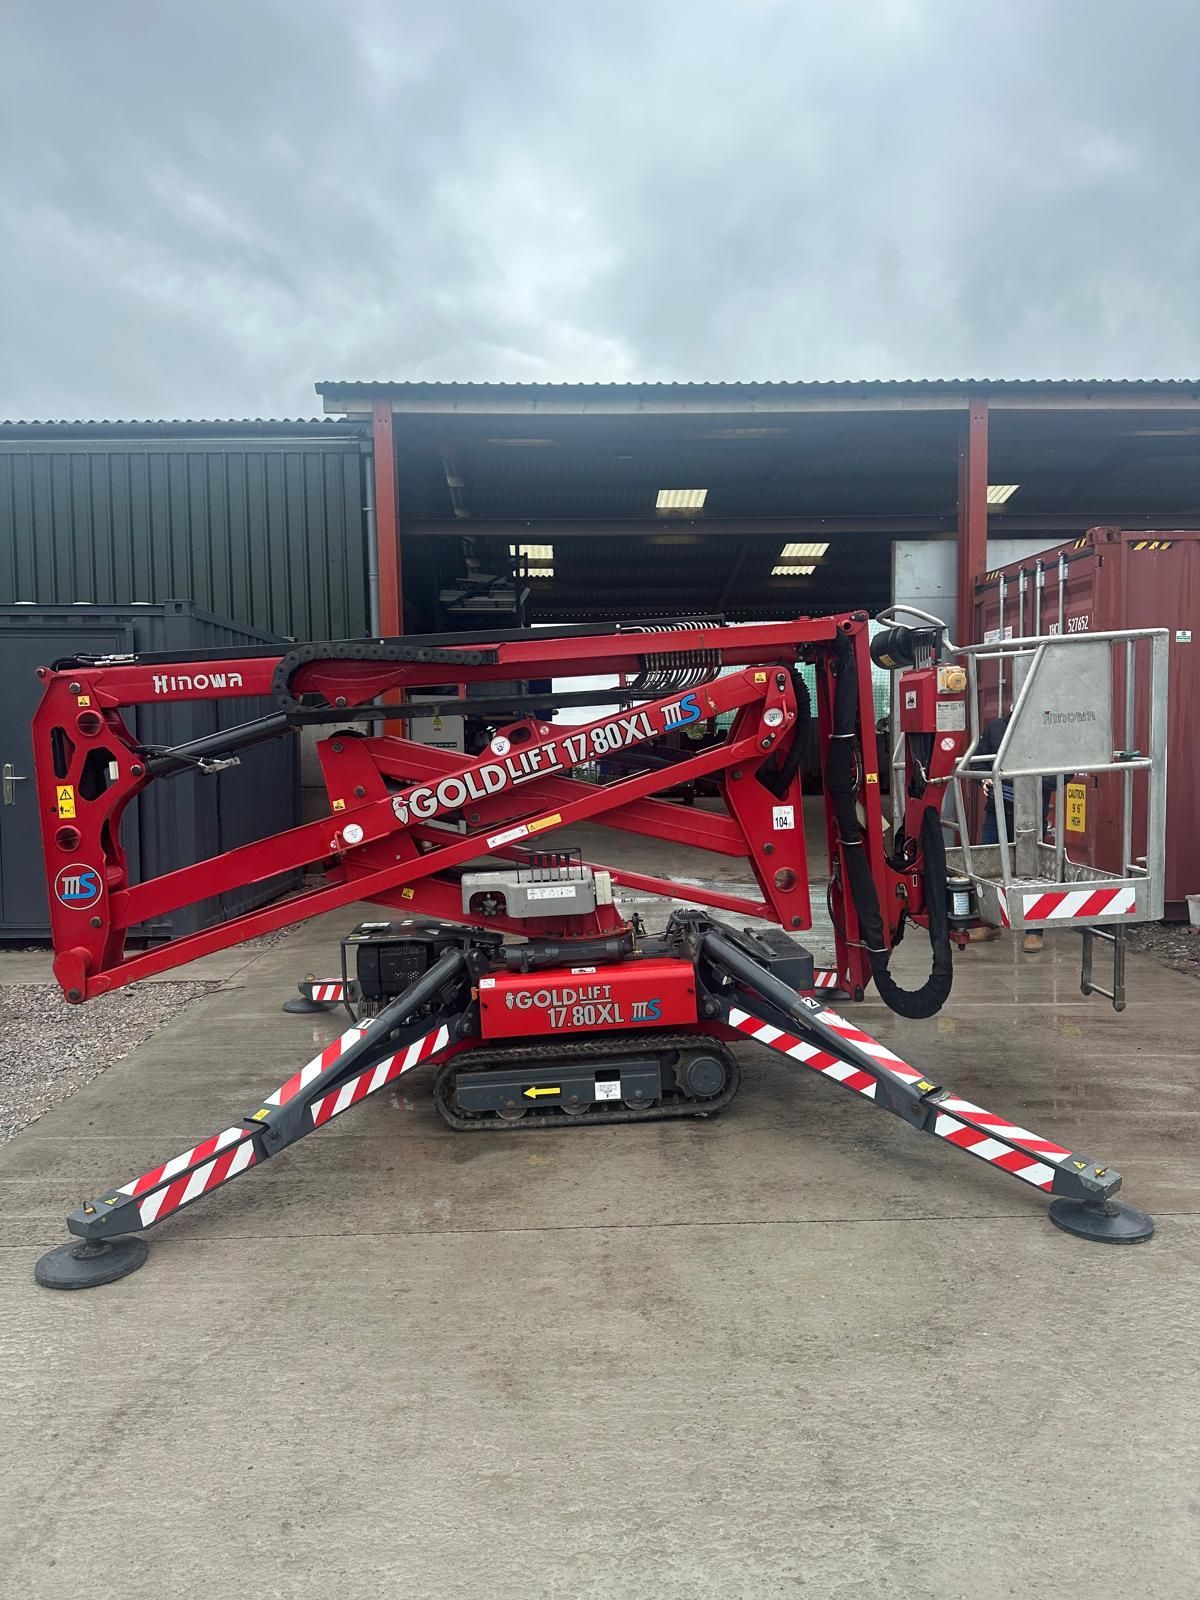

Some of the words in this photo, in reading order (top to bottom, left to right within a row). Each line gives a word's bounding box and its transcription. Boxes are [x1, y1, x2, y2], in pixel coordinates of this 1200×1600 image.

[1068, 615, 1089, 633] 527652
[562, 713, 659, 764] 17.80XL
[1068, 788, 1085, 800] CAUTION
[775, 816, 788, 828] 104
[547, 1003, 625, 1028] 17.80XL
